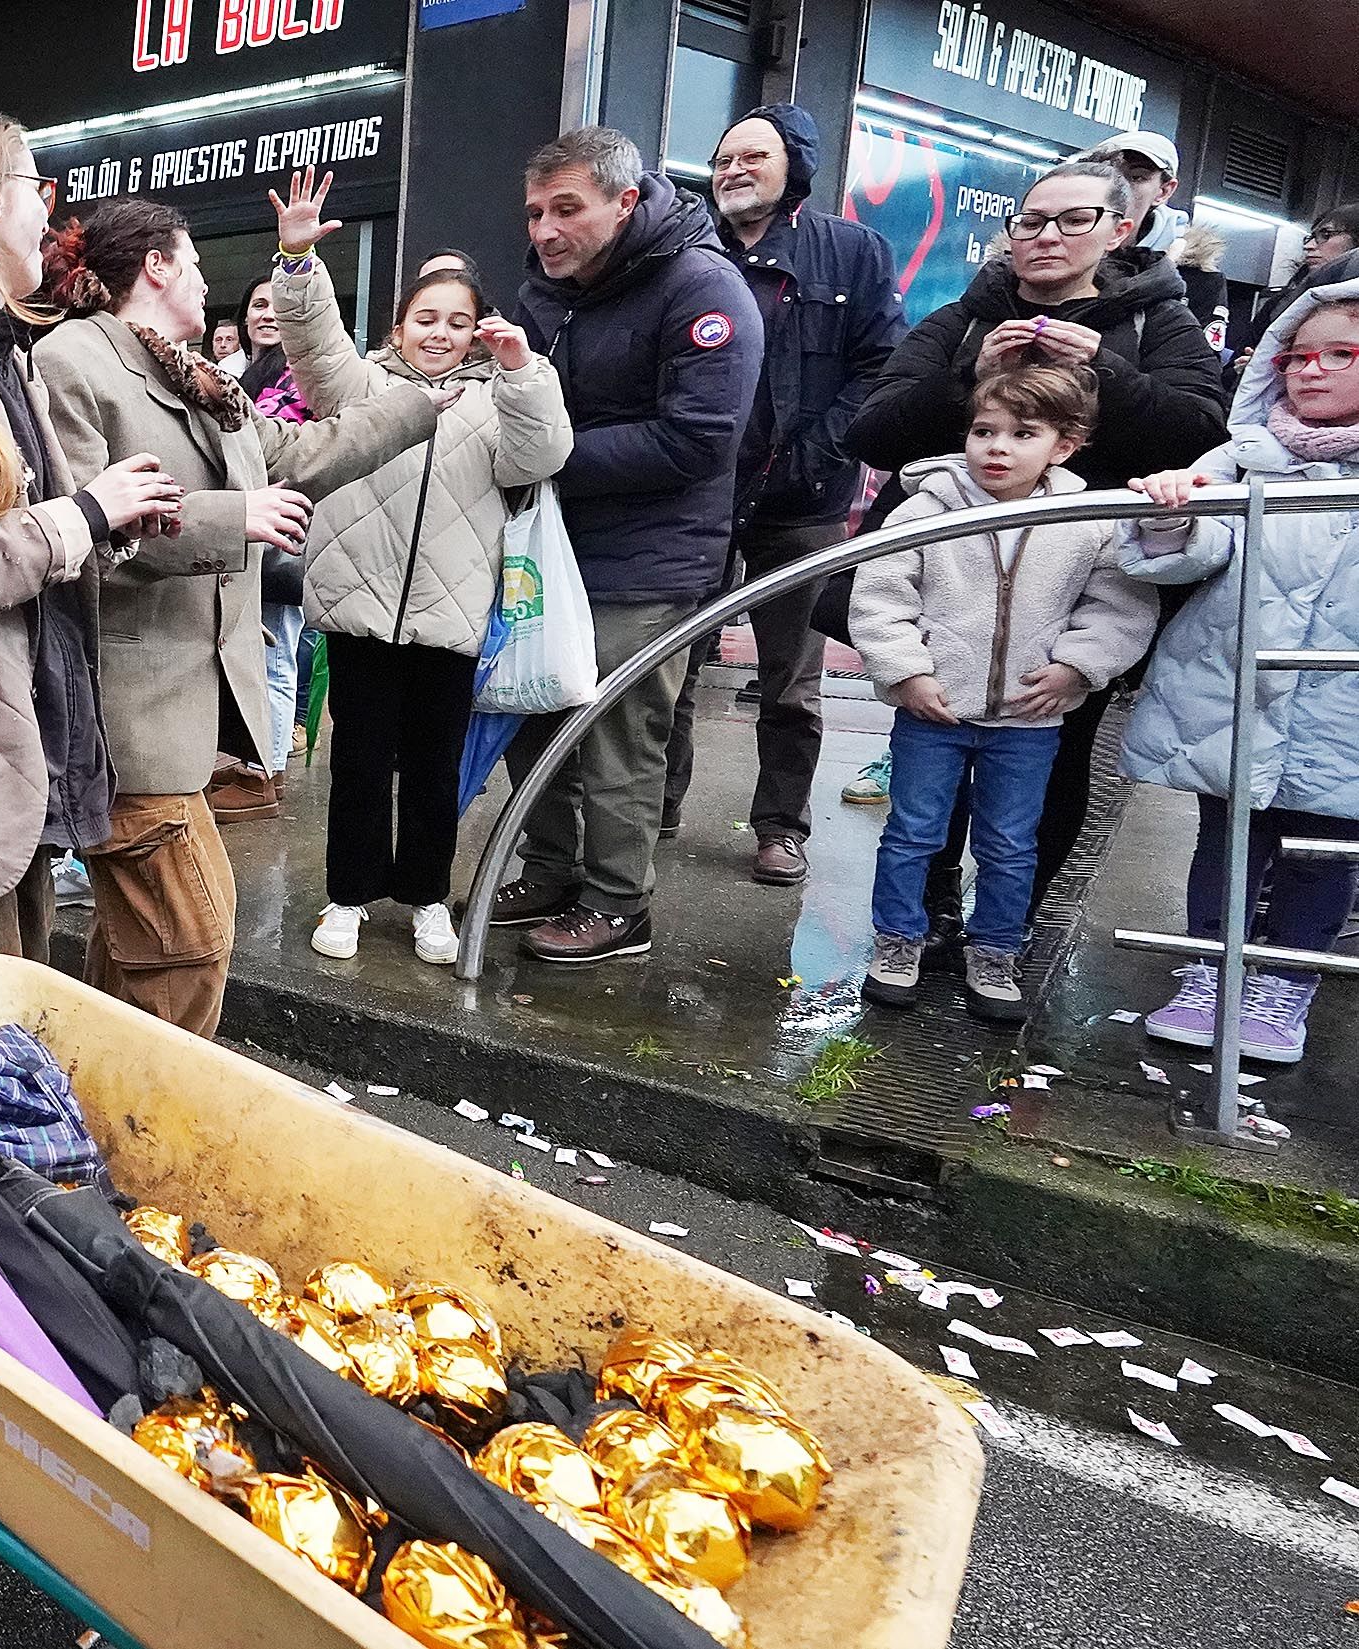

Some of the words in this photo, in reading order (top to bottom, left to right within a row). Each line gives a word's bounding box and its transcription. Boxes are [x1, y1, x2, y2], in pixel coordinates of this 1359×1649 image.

[133, 0, 192, 73] LA
[933, 0, 989, 81] SALÓN
[986, 21, 1006, 87] &
[1003, 28, 1077, 111] APUESTAS
[66, 157, 121, 203] SALÓN
[127, 157, 143, 193] &
[150, 139, 247, 190] APUESTAS
[254, 115, 383, 174] DEPORTIVAS
[955, 185, 1017, 223] prepara
[965, 232, 981, 264] la
